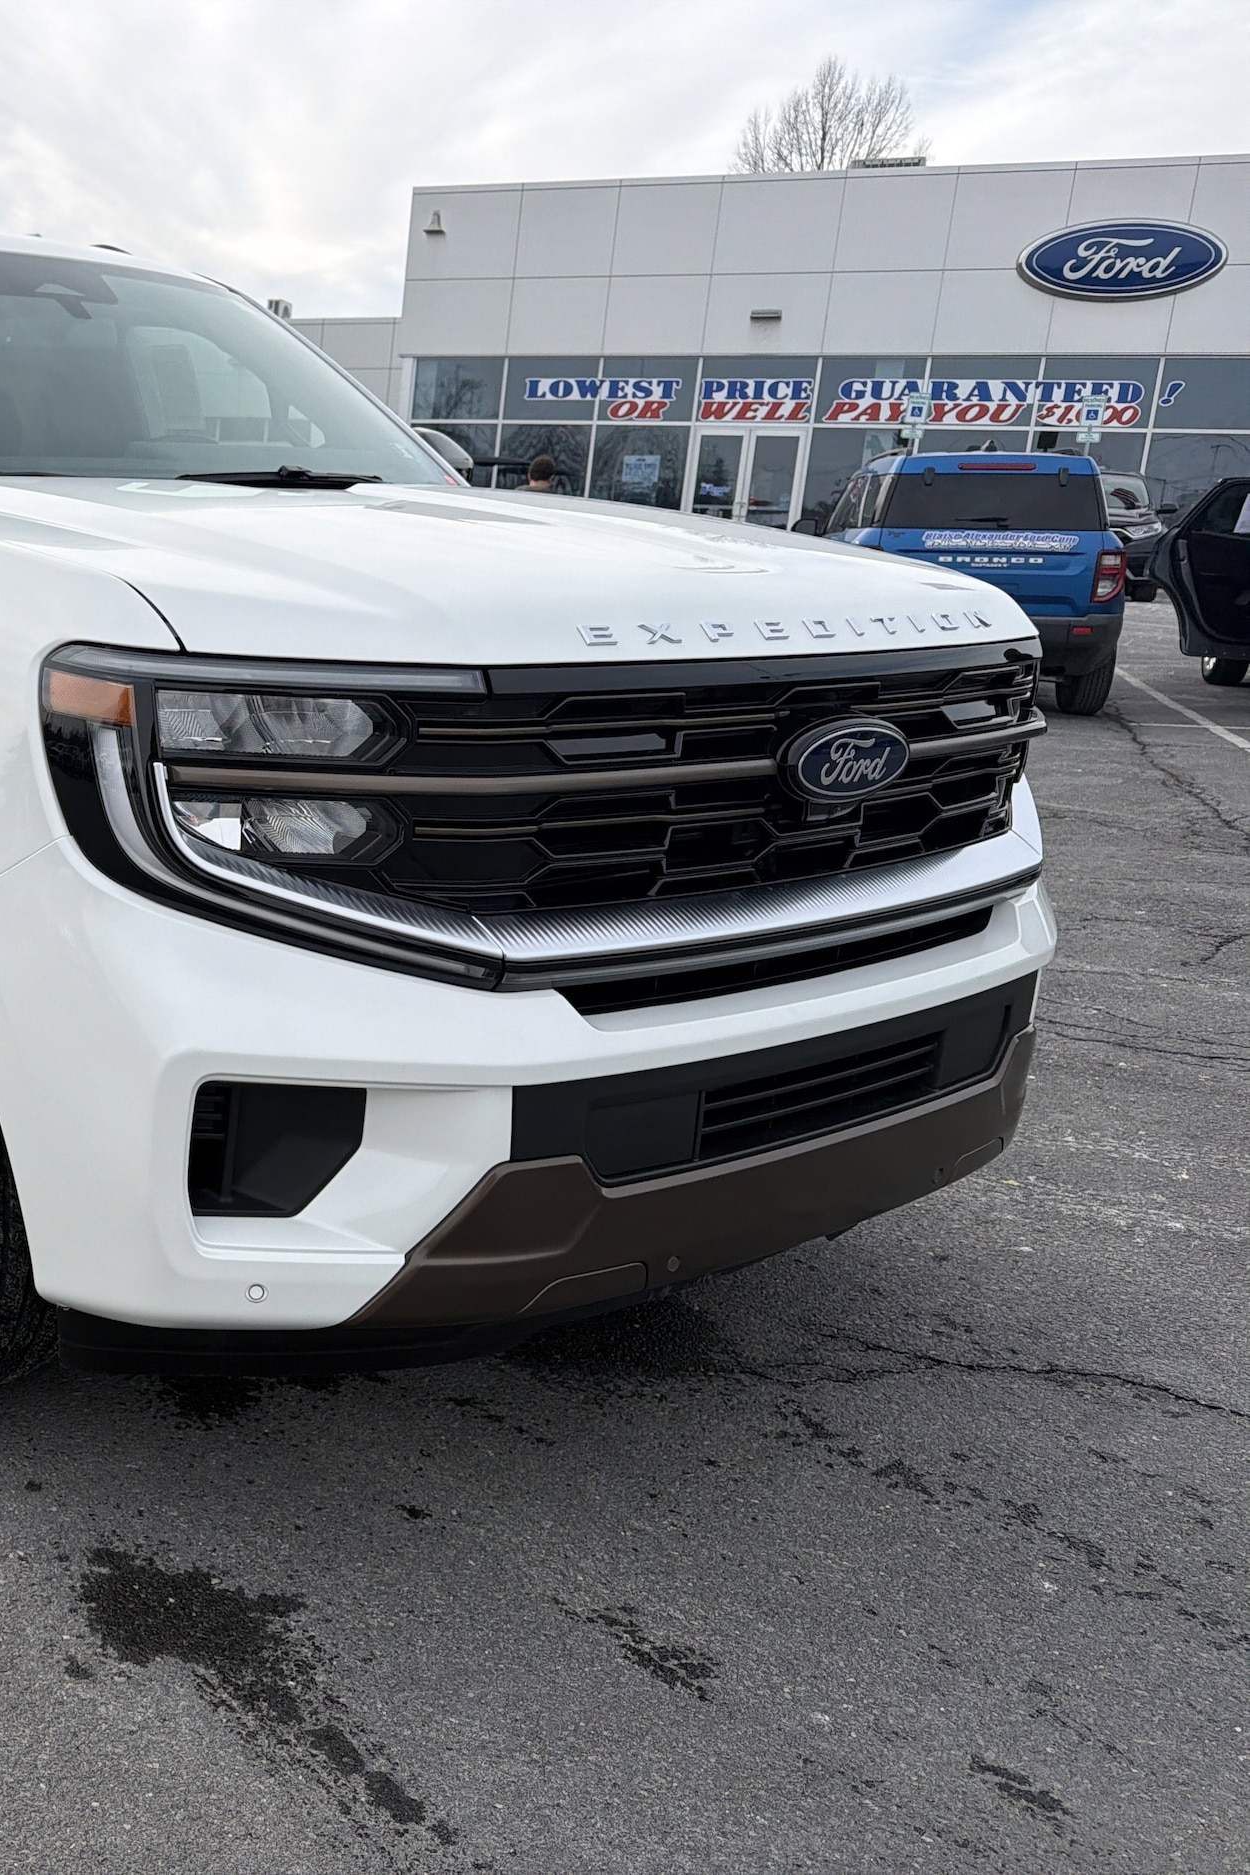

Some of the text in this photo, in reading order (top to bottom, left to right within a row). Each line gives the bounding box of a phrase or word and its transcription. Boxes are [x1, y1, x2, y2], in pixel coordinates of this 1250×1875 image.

[1063, 237, 1182, 280] Ford
[525, 379, 680, 399] LOWEST
[702, 379, 814, 400] PRICE
[840, 379, 1144, 404] GUARANTEED
[609, 401, 1140, 426] OR WE'LL PAY YOU $1,00
[938, 556, 1044, 564] BRONCO
[577, 609, 993, 647] EXPEDITION
[820, 737, 892, 786] Ford
